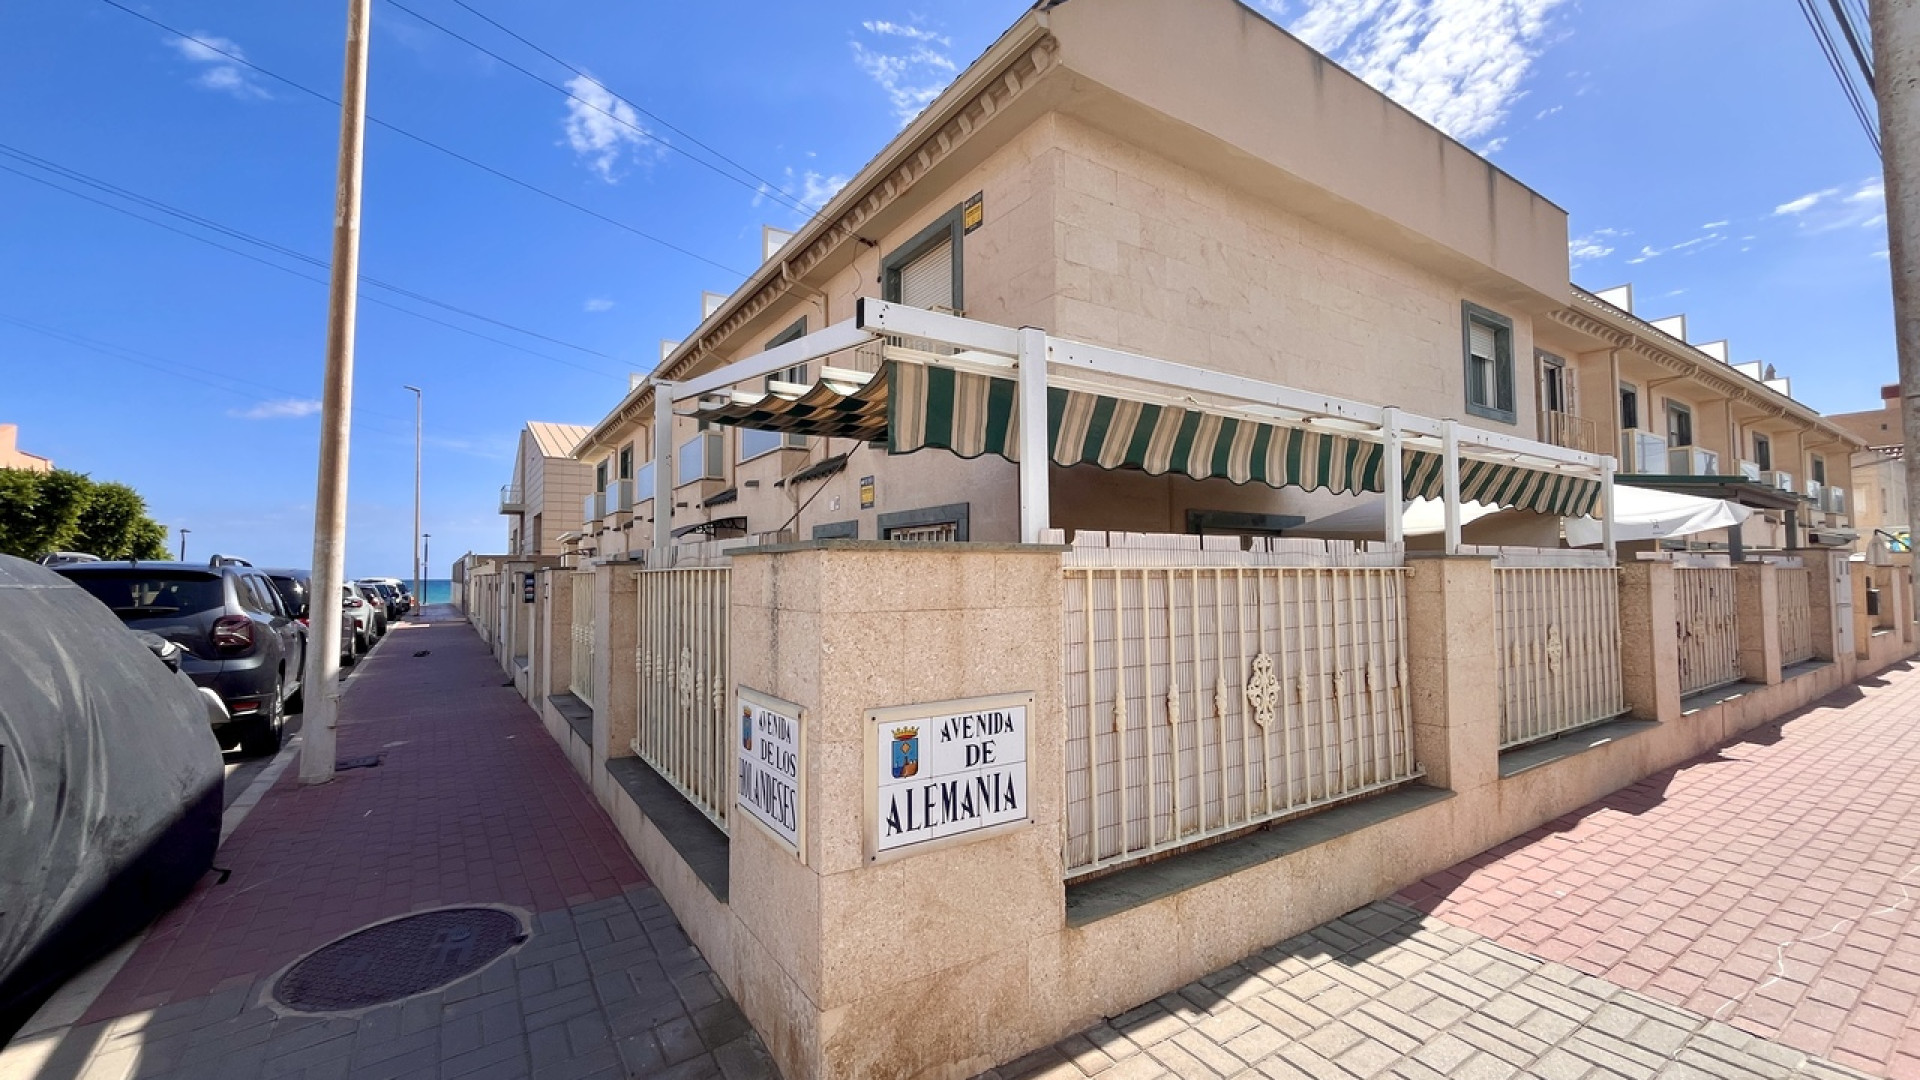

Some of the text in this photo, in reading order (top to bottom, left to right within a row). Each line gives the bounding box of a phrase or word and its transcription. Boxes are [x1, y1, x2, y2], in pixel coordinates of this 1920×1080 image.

[941, 712, 1014, 742] AVENIDA
[761, 738, 796, 777] DE LOS
[965, 740, 996, 767] DE
[886, 771, 1017, 837] ALEMANIA
